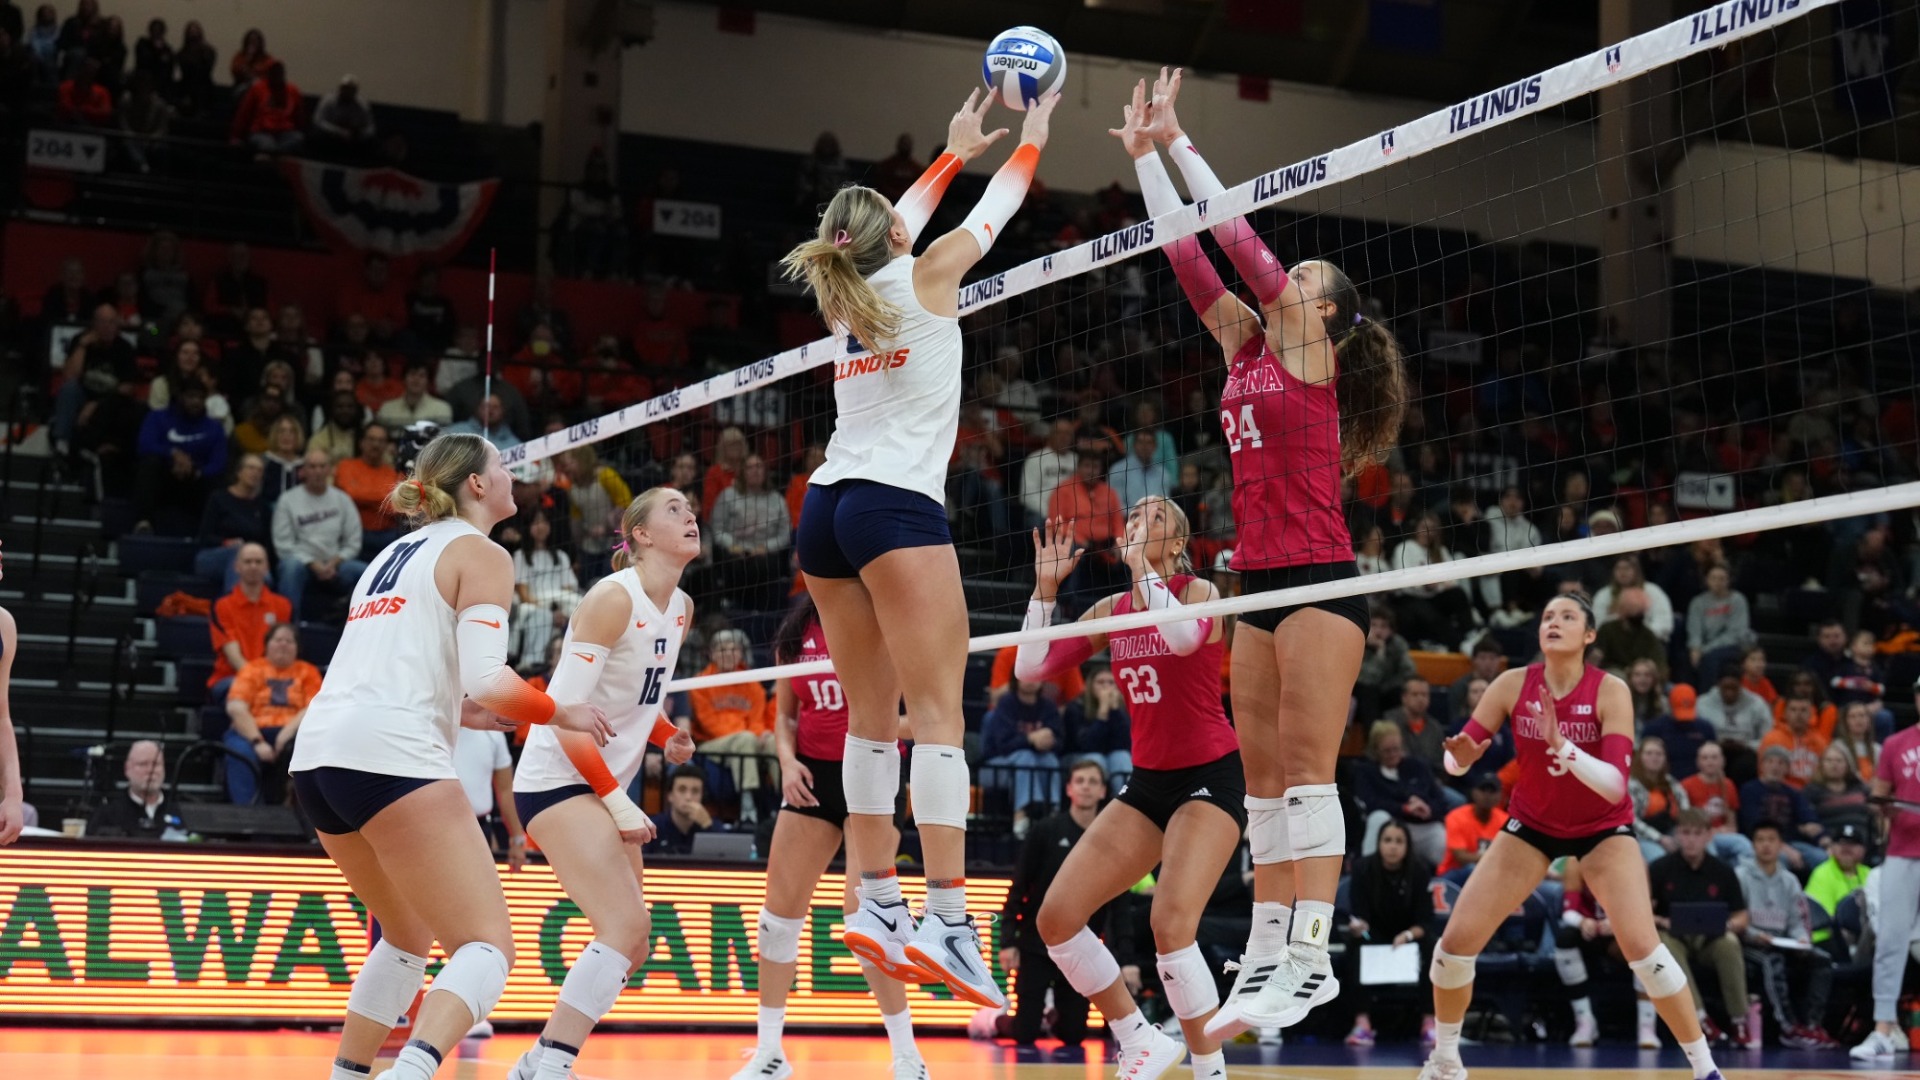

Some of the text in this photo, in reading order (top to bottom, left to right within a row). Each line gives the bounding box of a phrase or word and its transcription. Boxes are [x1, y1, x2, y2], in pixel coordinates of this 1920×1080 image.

[993, 56, 1038, 71] molten
[1448, 75, 1541, 134] ILLINOIS
[33, 137, 73, 160] 204
[1252, 155, 1328, 203] ILLINOIS
[680, 208, 715, 229] 204
[1090, 219, 1155, 263] ILLINOIS
[958, 272, 1006, 310] LLINOIS
[734, 358, 775, 389] ILLINOIS
[834, 348, 910, 381] LLINOIS
[1221, 404, 1263, 454] 24
[366, 537, 429, 597] 10
[637, 667, 667, 706] 16
[807, 679, 844, 711] 10
[1119, 664, 1162, 705] 23
[1545, 747, 1570, 778] 3
